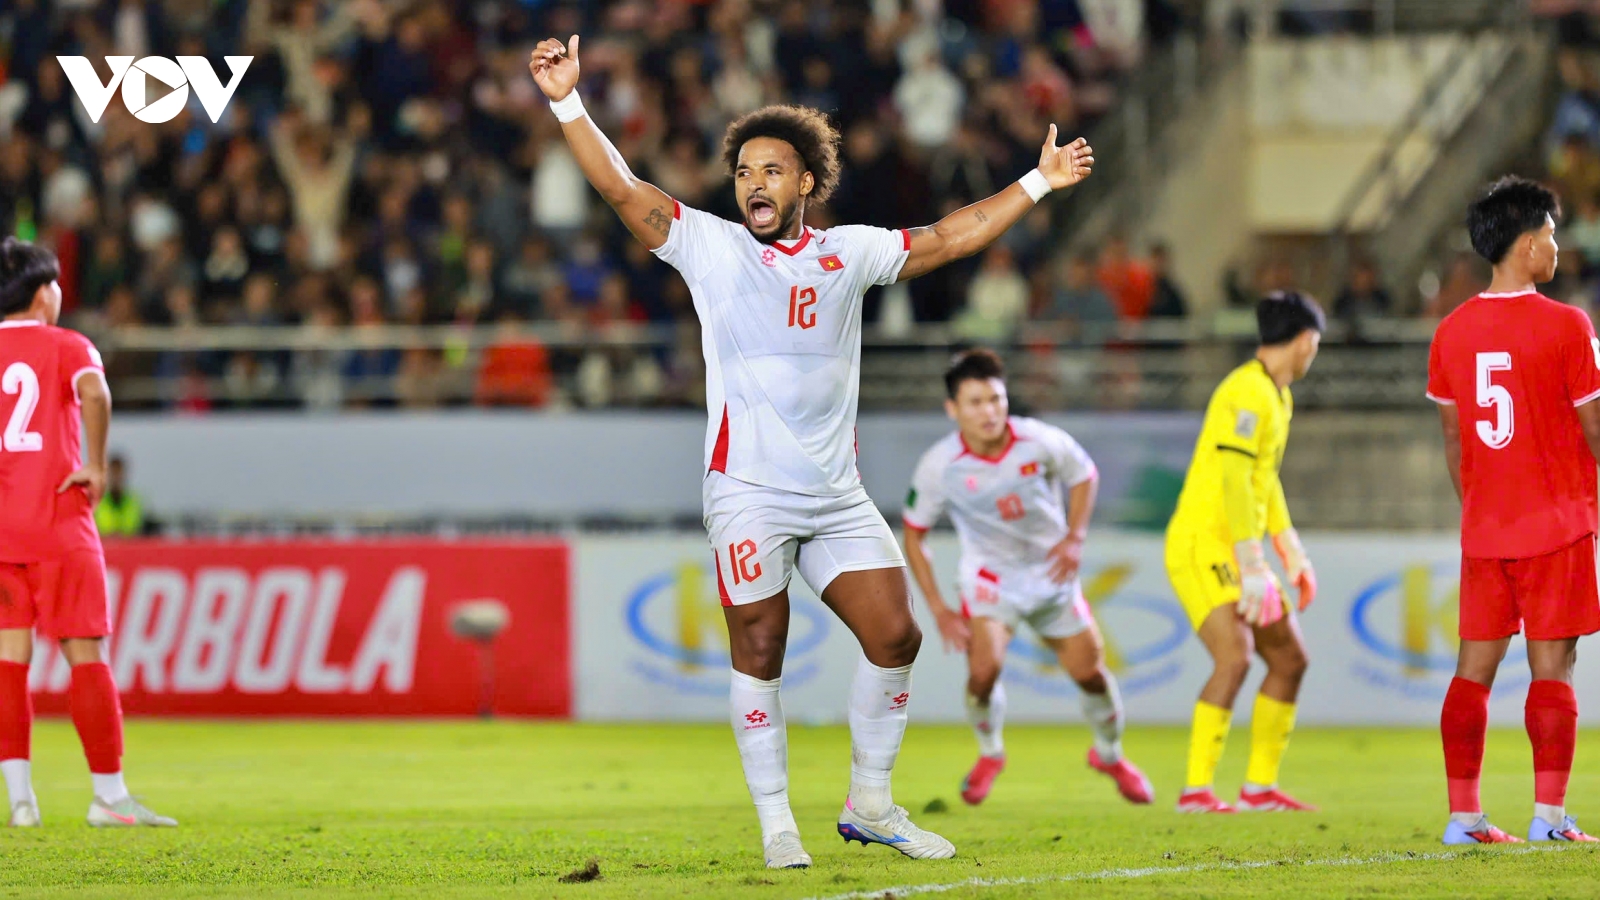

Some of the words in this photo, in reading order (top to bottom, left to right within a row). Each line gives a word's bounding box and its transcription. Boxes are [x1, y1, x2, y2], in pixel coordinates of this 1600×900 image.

[788, 285, 817, 329] 12
[0, 362, 42, 452] 2
[1476, 352, 1514, 449] 5
[729, 539, 762, 585] 12
[29, 567, 427, 692] RBOLA
